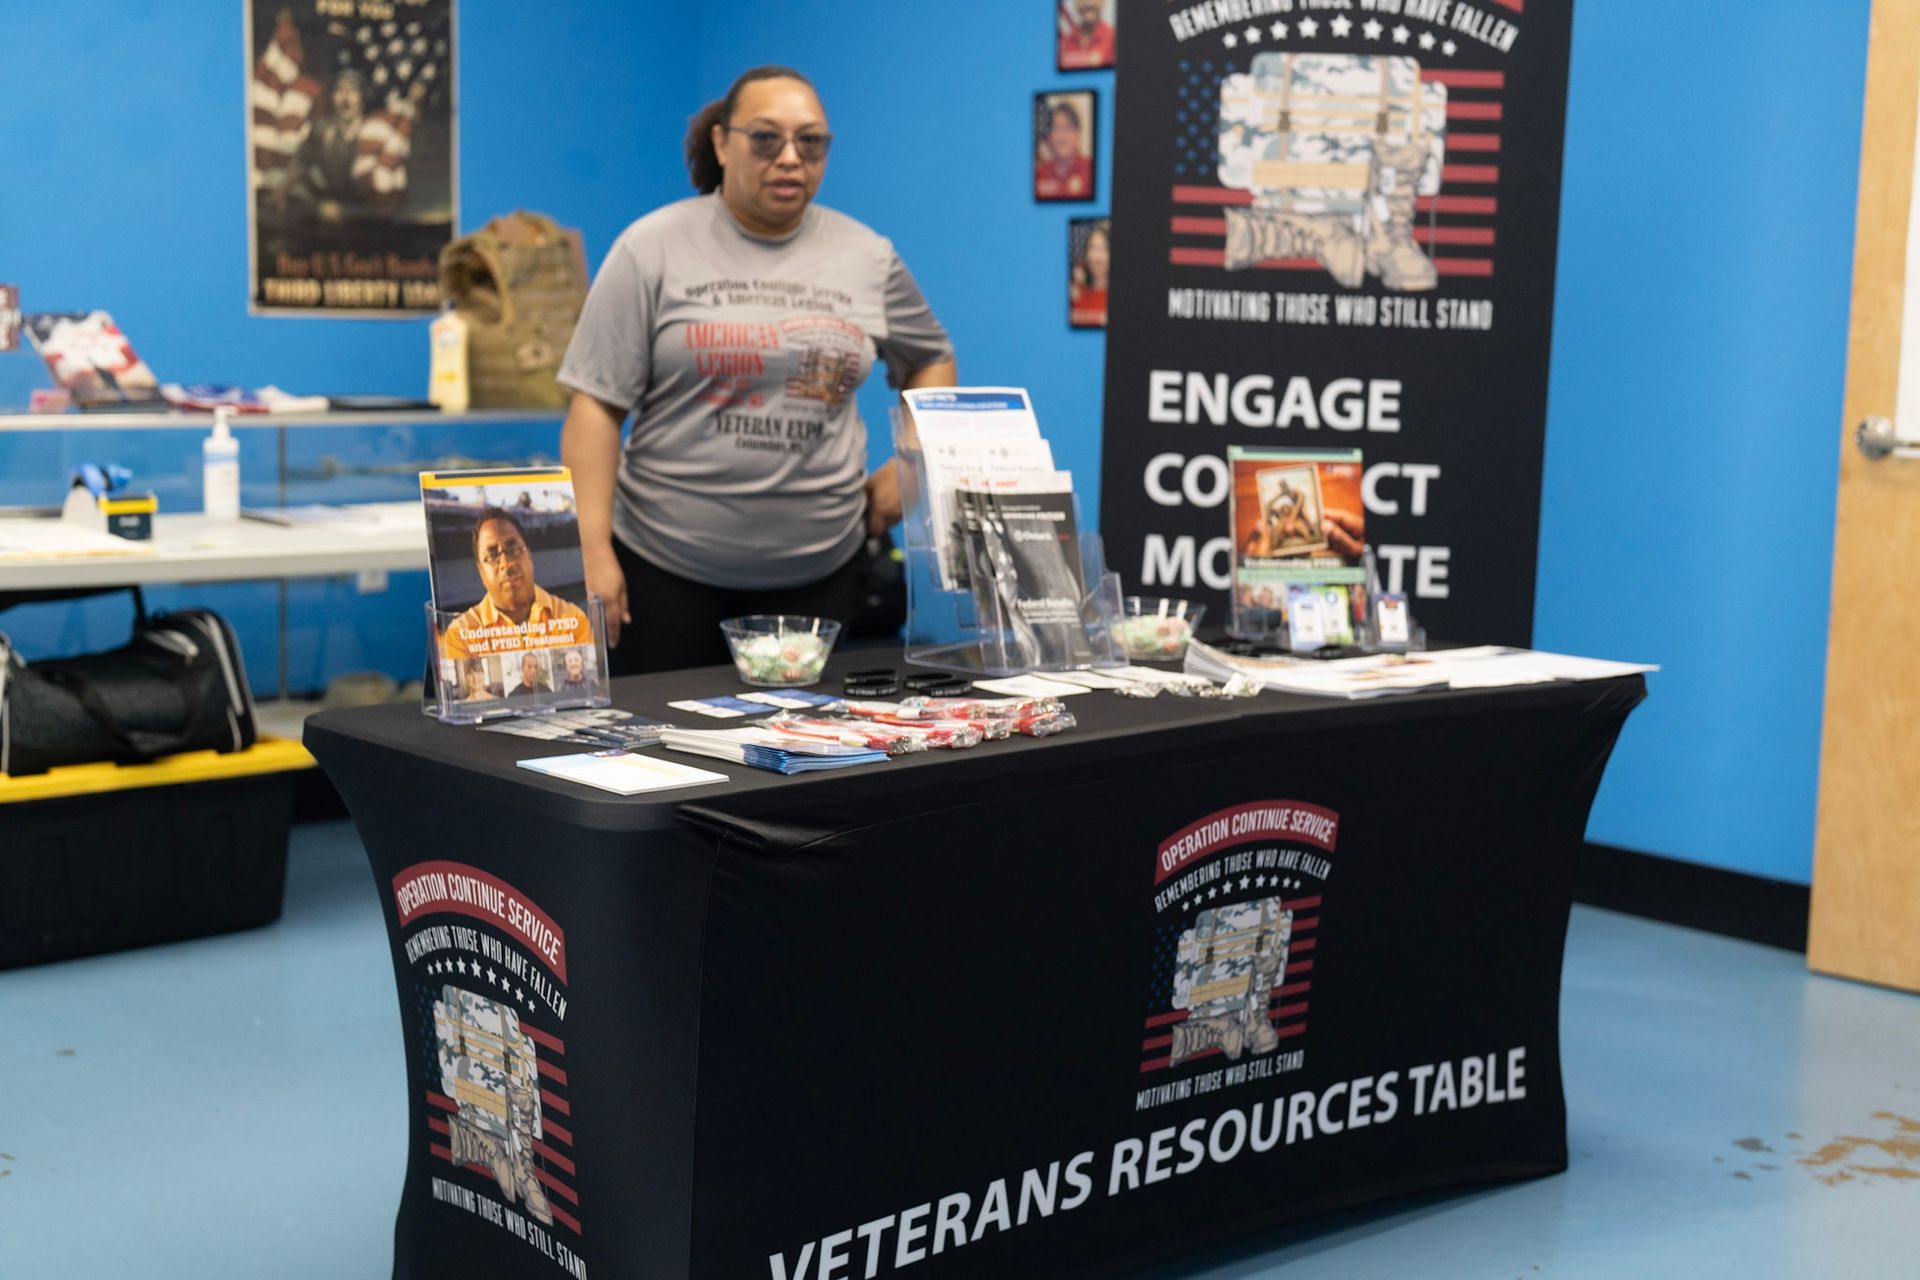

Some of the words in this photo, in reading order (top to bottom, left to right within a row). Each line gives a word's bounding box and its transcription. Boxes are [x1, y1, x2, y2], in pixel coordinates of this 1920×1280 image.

[1404, 0, 1447, 26] HAVE
[1450, 2, 1519, 53] FALLEN
[684, 322, 780, 351] AMERICAN
[1168, 287, 1271, 322] MOTIVATING
[1275, 291, 1330, 325] THOSE
[1335, 294, 1377, 326] WHO
[1379, 296, 1431, 328] STILL
[1436, 298, 1493, 330] STAND
[696, 352, 764, 377] LEGION
[716, 413, 780, 435] VETERAN
[1148, 369, 1402, 432] ENGAGE
[1143, 452, 1441, 516] COCT
[1141, 533, 1450, 599] MOTE
[460, 621, 546, 641] Understanding
[548, 618, 579, 632] PTSD
[468, 640, 489, 653] and
[491, 636, 520, 651] PTSD
[522, 632, 575, 647] Treatment
[1161, 817, 1229, 872] OPERATION
[1232, 808, 1290, 835] CONTINUE
[1290, 809, 1336, 844] SERVICE
[1154, 860, 1221, 913] REMEMBERING
[1224, 851, 1254, 875] THOSE
[1255, 849, 1278, 869] WHO
[1278, 849, 1301, 870] HAVE
[1300, 852, 1332, 881] FALLEN
[397, 872, 447, 917] OPERATION
[447, 873, 505, 919] CONTINUE
[508, 898, 562, 966] SERVICE
[405, 925, 451, 965] REMEMBERING
[451, 925, 480, 955] THOSE
[480, 932, 503, 964] WHO
[504, 945, 528, 980] HAVE
[530, 963, 567, 1022] FALLEN
[1136, 1076, 1191, 1112] MOTIVATING
[1194, 1069, 1223, 1096] THOSE
[1225, 1063, 1248, 1087] WHO
[1248, 1056, 1274, 1082] STILL
[1275, 1049, 1305, 1074] STAND
[769, 1151, 1095, 1280] VETERANS
[1107, 1071, 1399, 1197] RESOURCES
[1409, 1046, 1526, 1116] TABLE
[432, 1175, 476, 1215] MOTIVATING
[476, 1193, 503, 1228] THOSE
[504, 1205, 527, 1239] WHO
[527, 1217, 556, 1259] STILL
[556, 1233, 587, 1280] STAND
